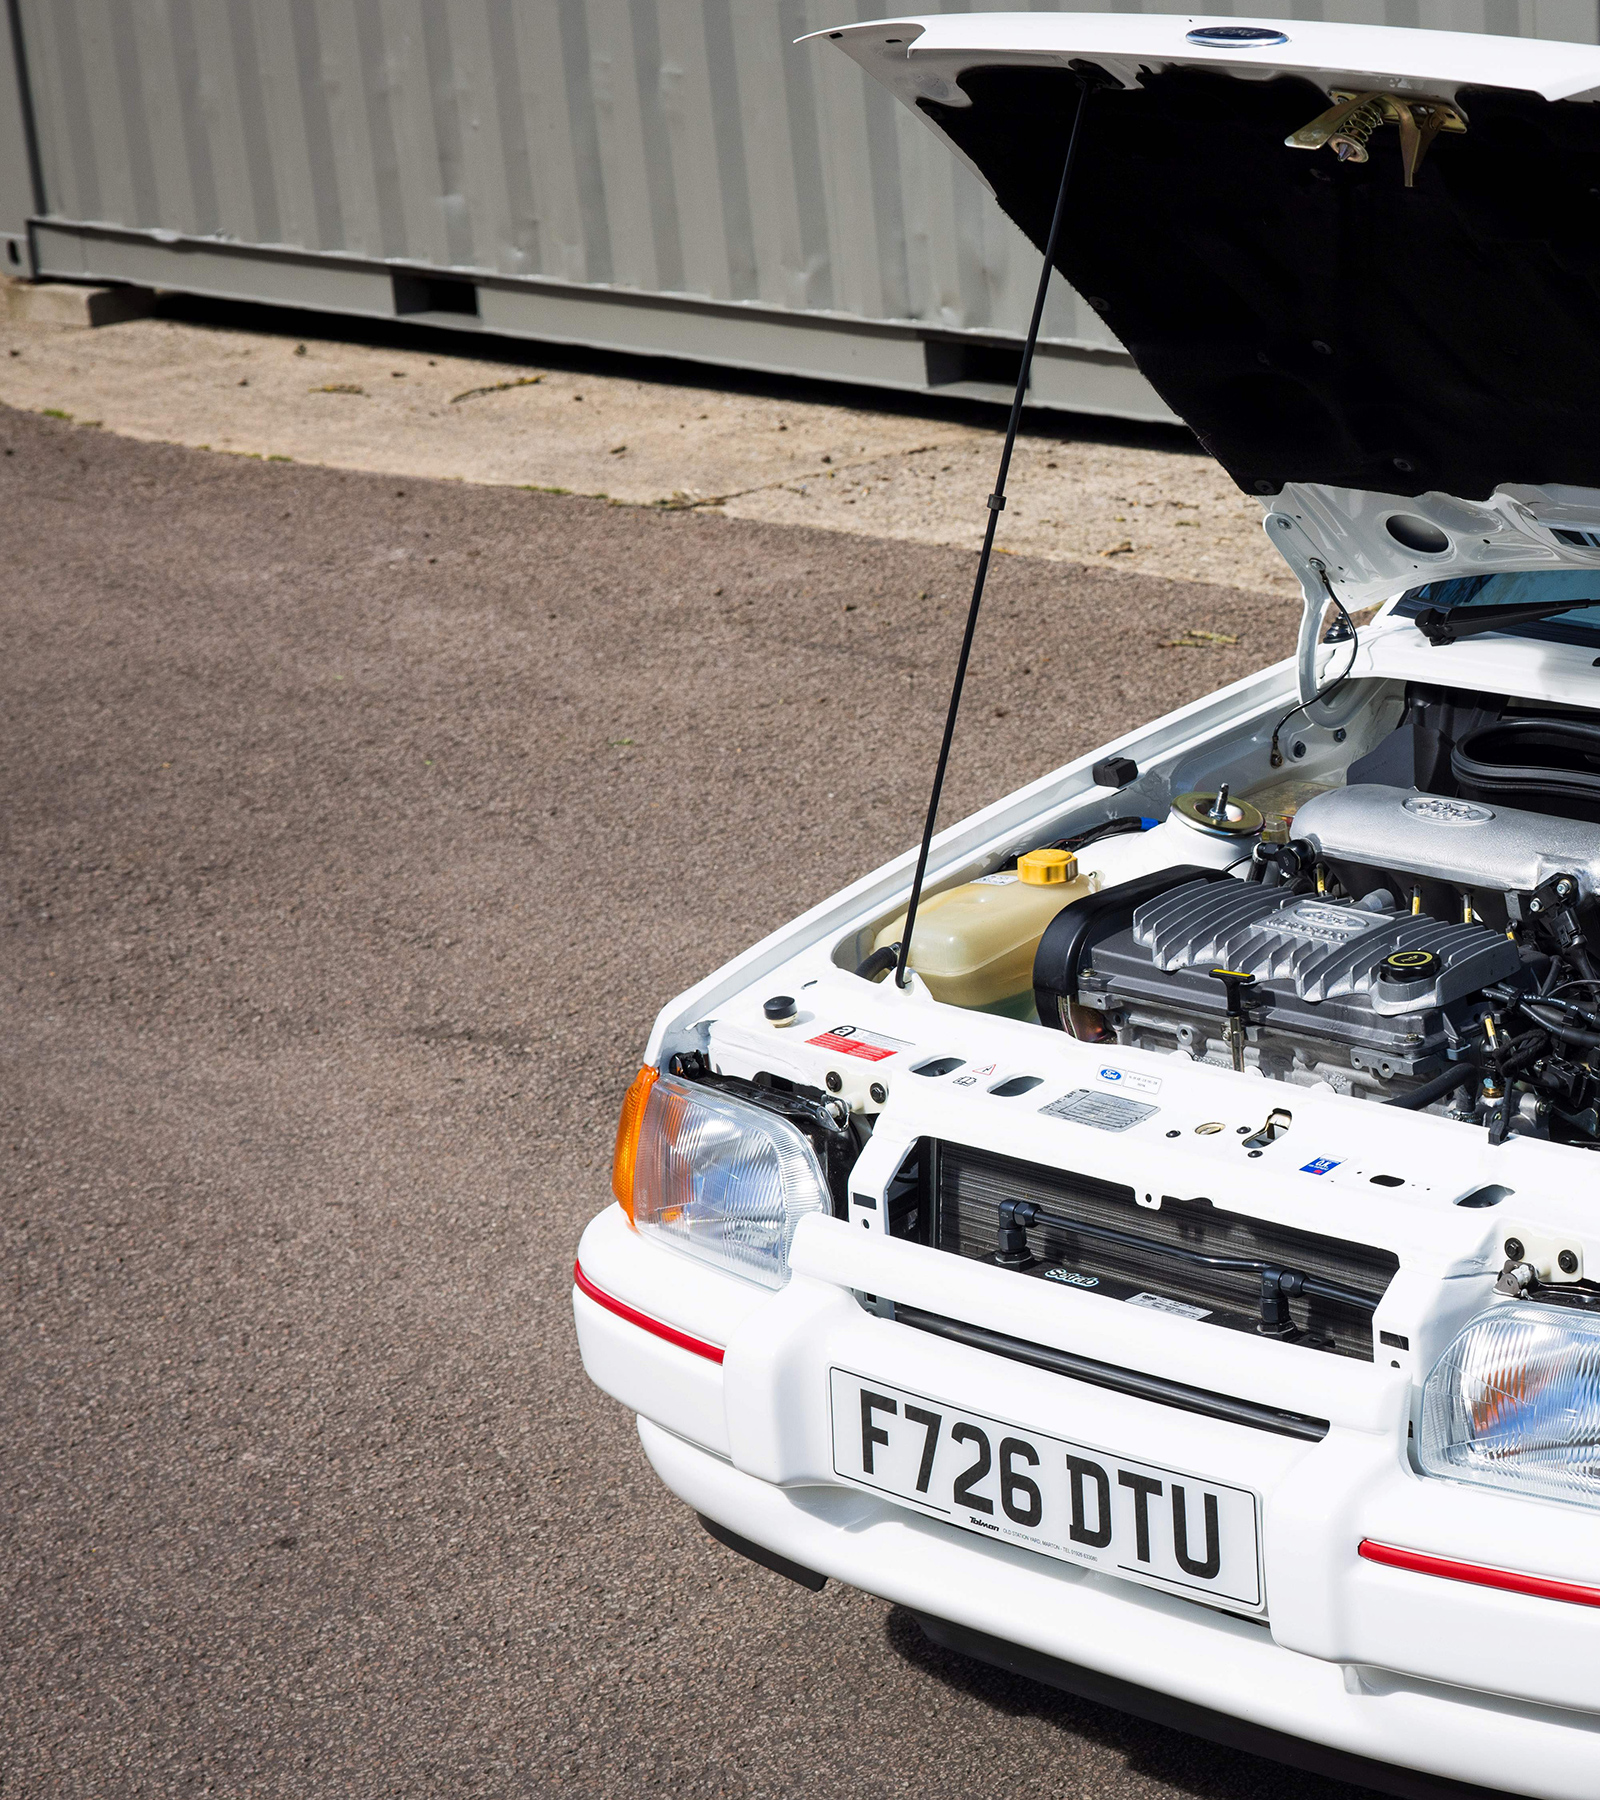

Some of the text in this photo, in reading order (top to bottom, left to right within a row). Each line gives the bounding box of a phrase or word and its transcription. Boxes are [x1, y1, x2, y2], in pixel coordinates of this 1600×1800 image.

[1103, 1070, 1119, 1080] Ford
[1045, 1268, 1099, 1287] Setrab
[860, 1388, 1221, 1580] F726 DTU
[969, 1515, 1000, 1532] Tolman
[1012, 1530, 1029, 1540] STATION
